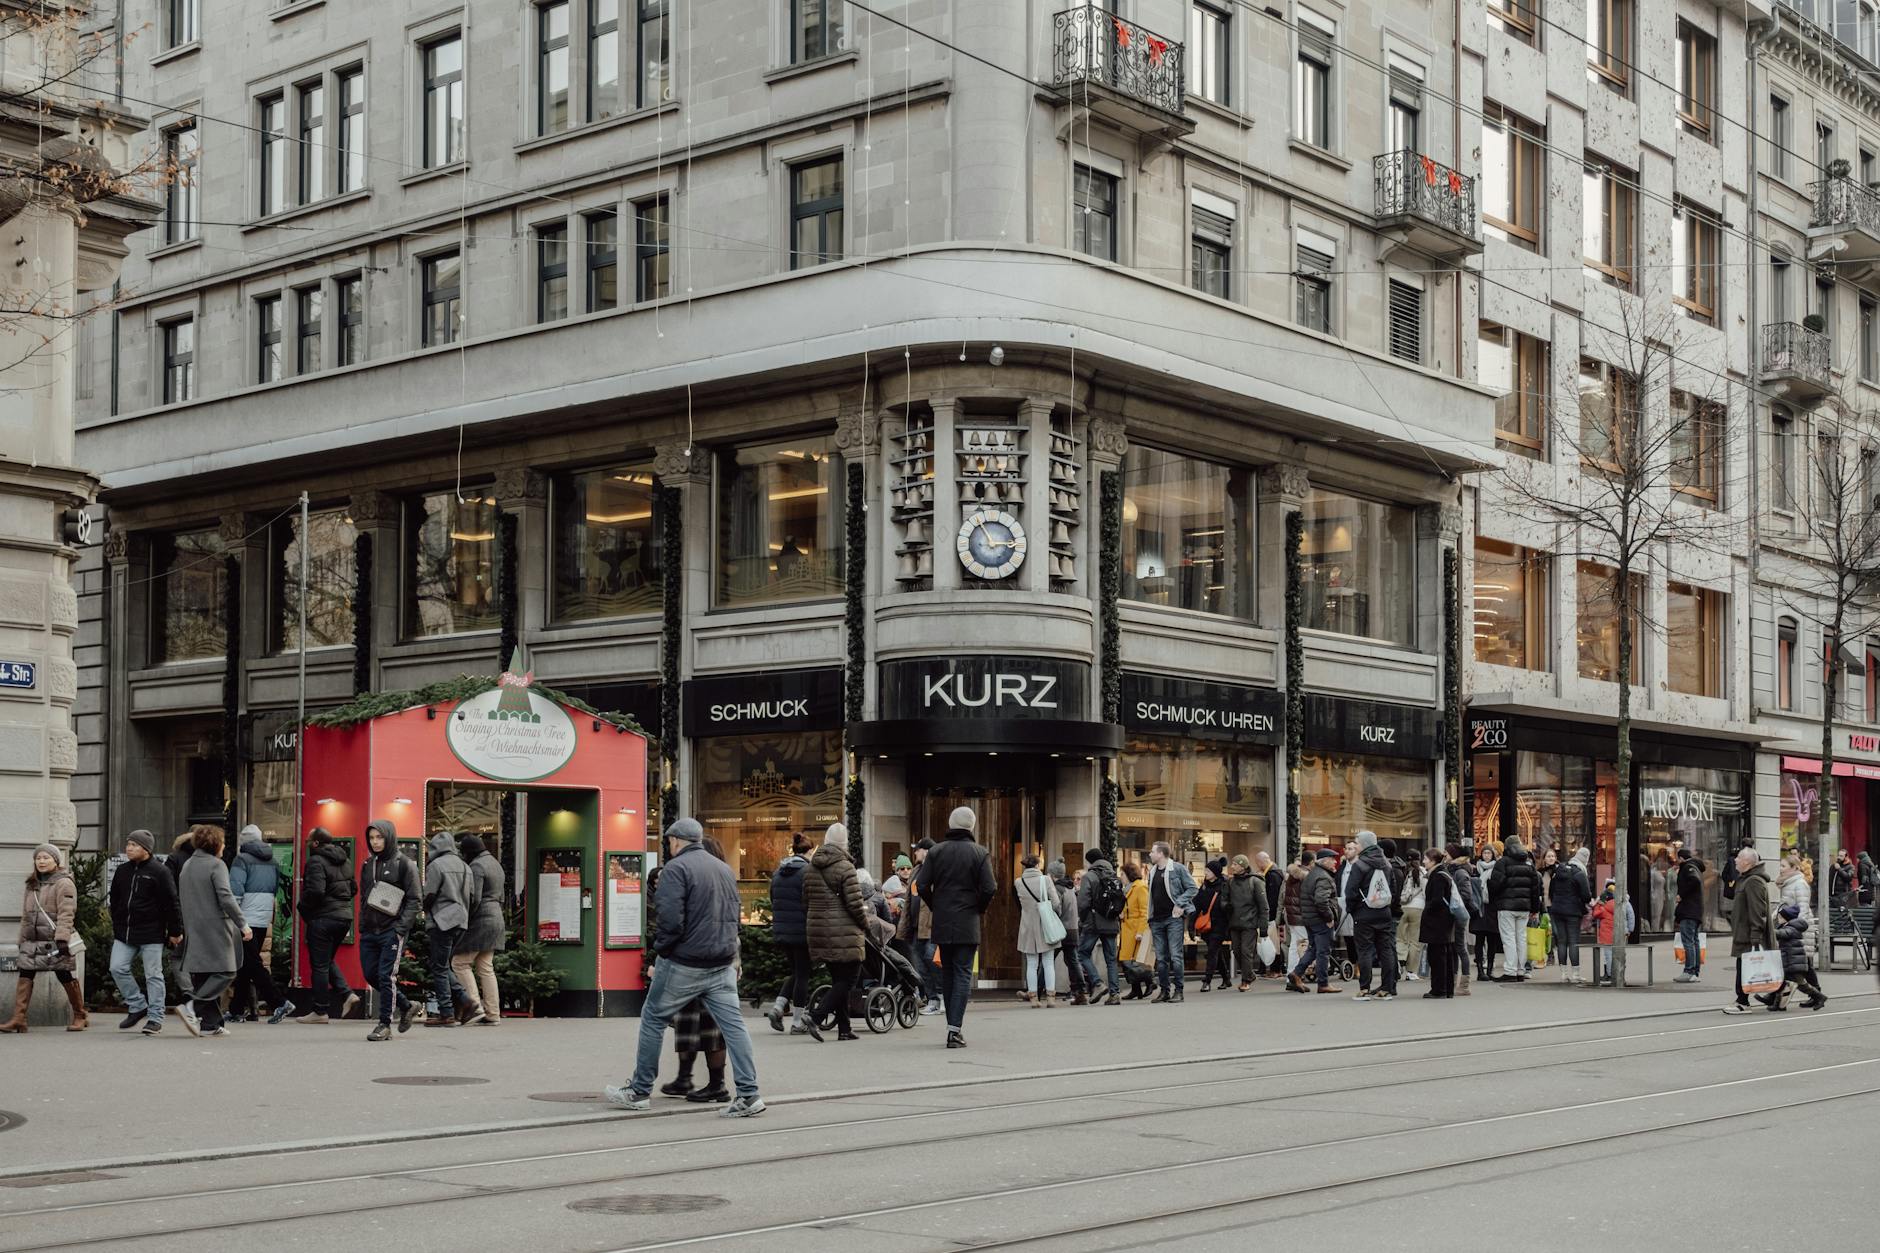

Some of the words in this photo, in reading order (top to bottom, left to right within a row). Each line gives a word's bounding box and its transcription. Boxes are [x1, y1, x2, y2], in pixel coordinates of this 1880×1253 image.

[78, 509, 92, 545] 82
[12, 664, 30, 682] Str.
[924, 673, 1058, 709] KURZ
[710, 699, 809, 721] SCHMUCK
[1136, 701, 1217, 726] SCHMUCK
[1221, 710, 1274, 732] UHREN
[455, 721, 496, 743] Singing
[498, 720, 541, 738] Christmas
[544, 723, 566, 741] Tree
[1360, 725, 1395, 743] KURZ
[1471, 719, 1507, 730] BEAUTY
